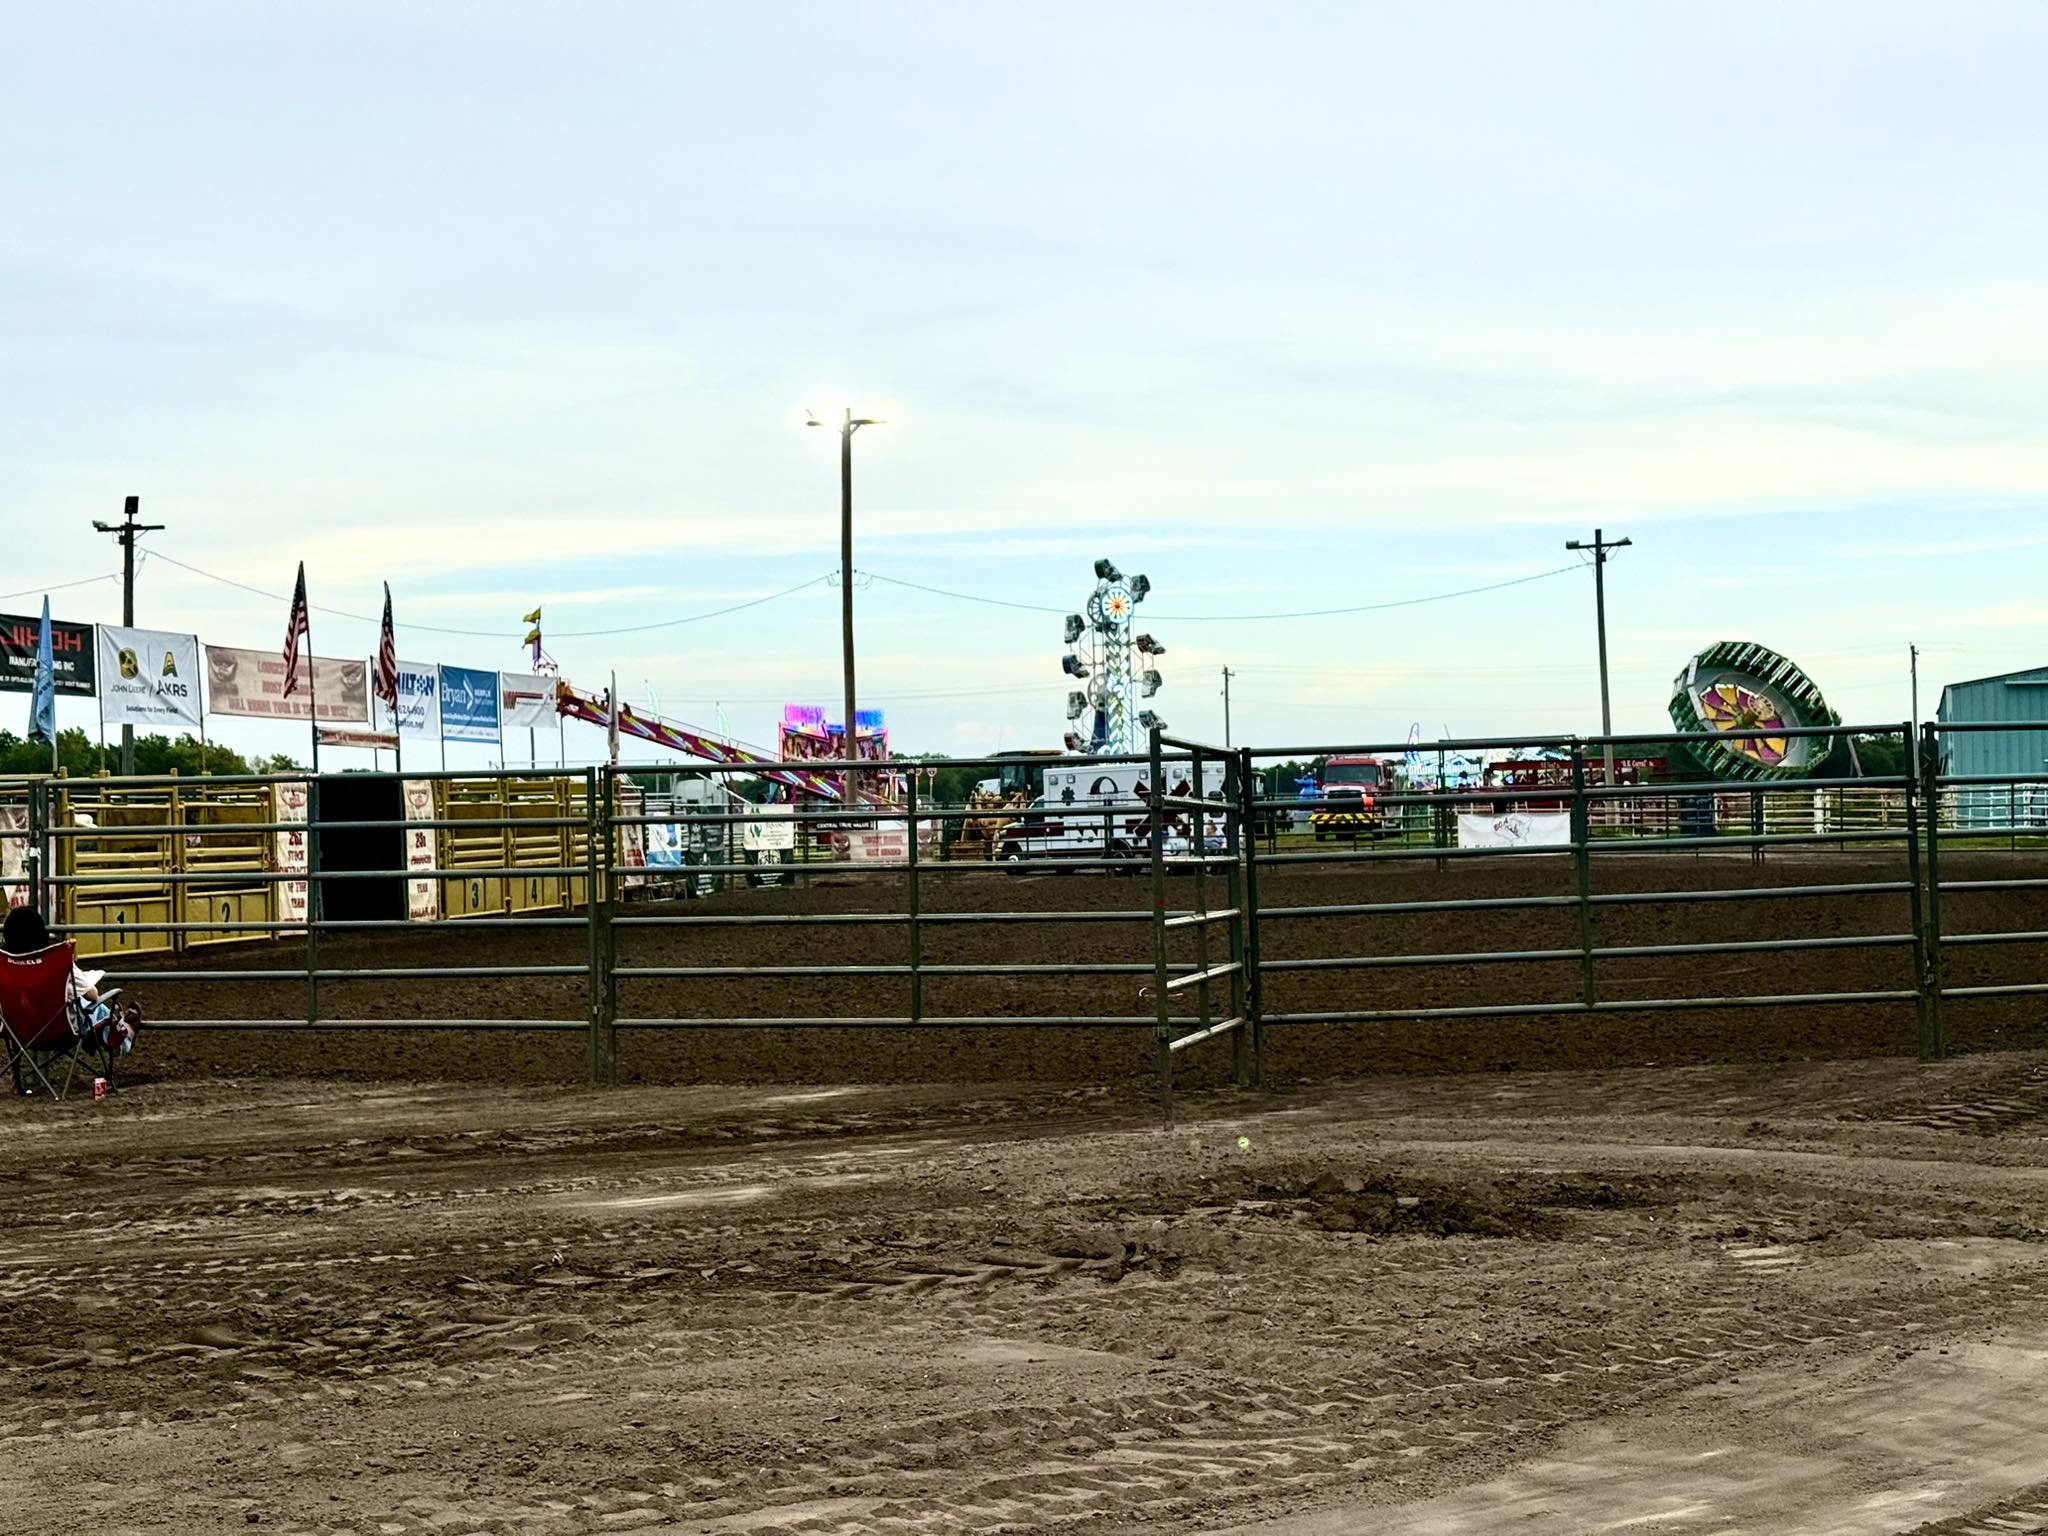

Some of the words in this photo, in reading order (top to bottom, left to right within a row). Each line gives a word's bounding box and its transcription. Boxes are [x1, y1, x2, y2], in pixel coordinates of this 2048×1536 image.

[111, 684, 128, 692] JOHN
[156, 680, 188, 697] AKRS
[441, 683, 466, 707] Bryan
[472, 882, 479, 908] 3
[531, 879, 537, 903] 4
[117, 911, 125, 944] 1
[222, 902, 230, 934] 2
